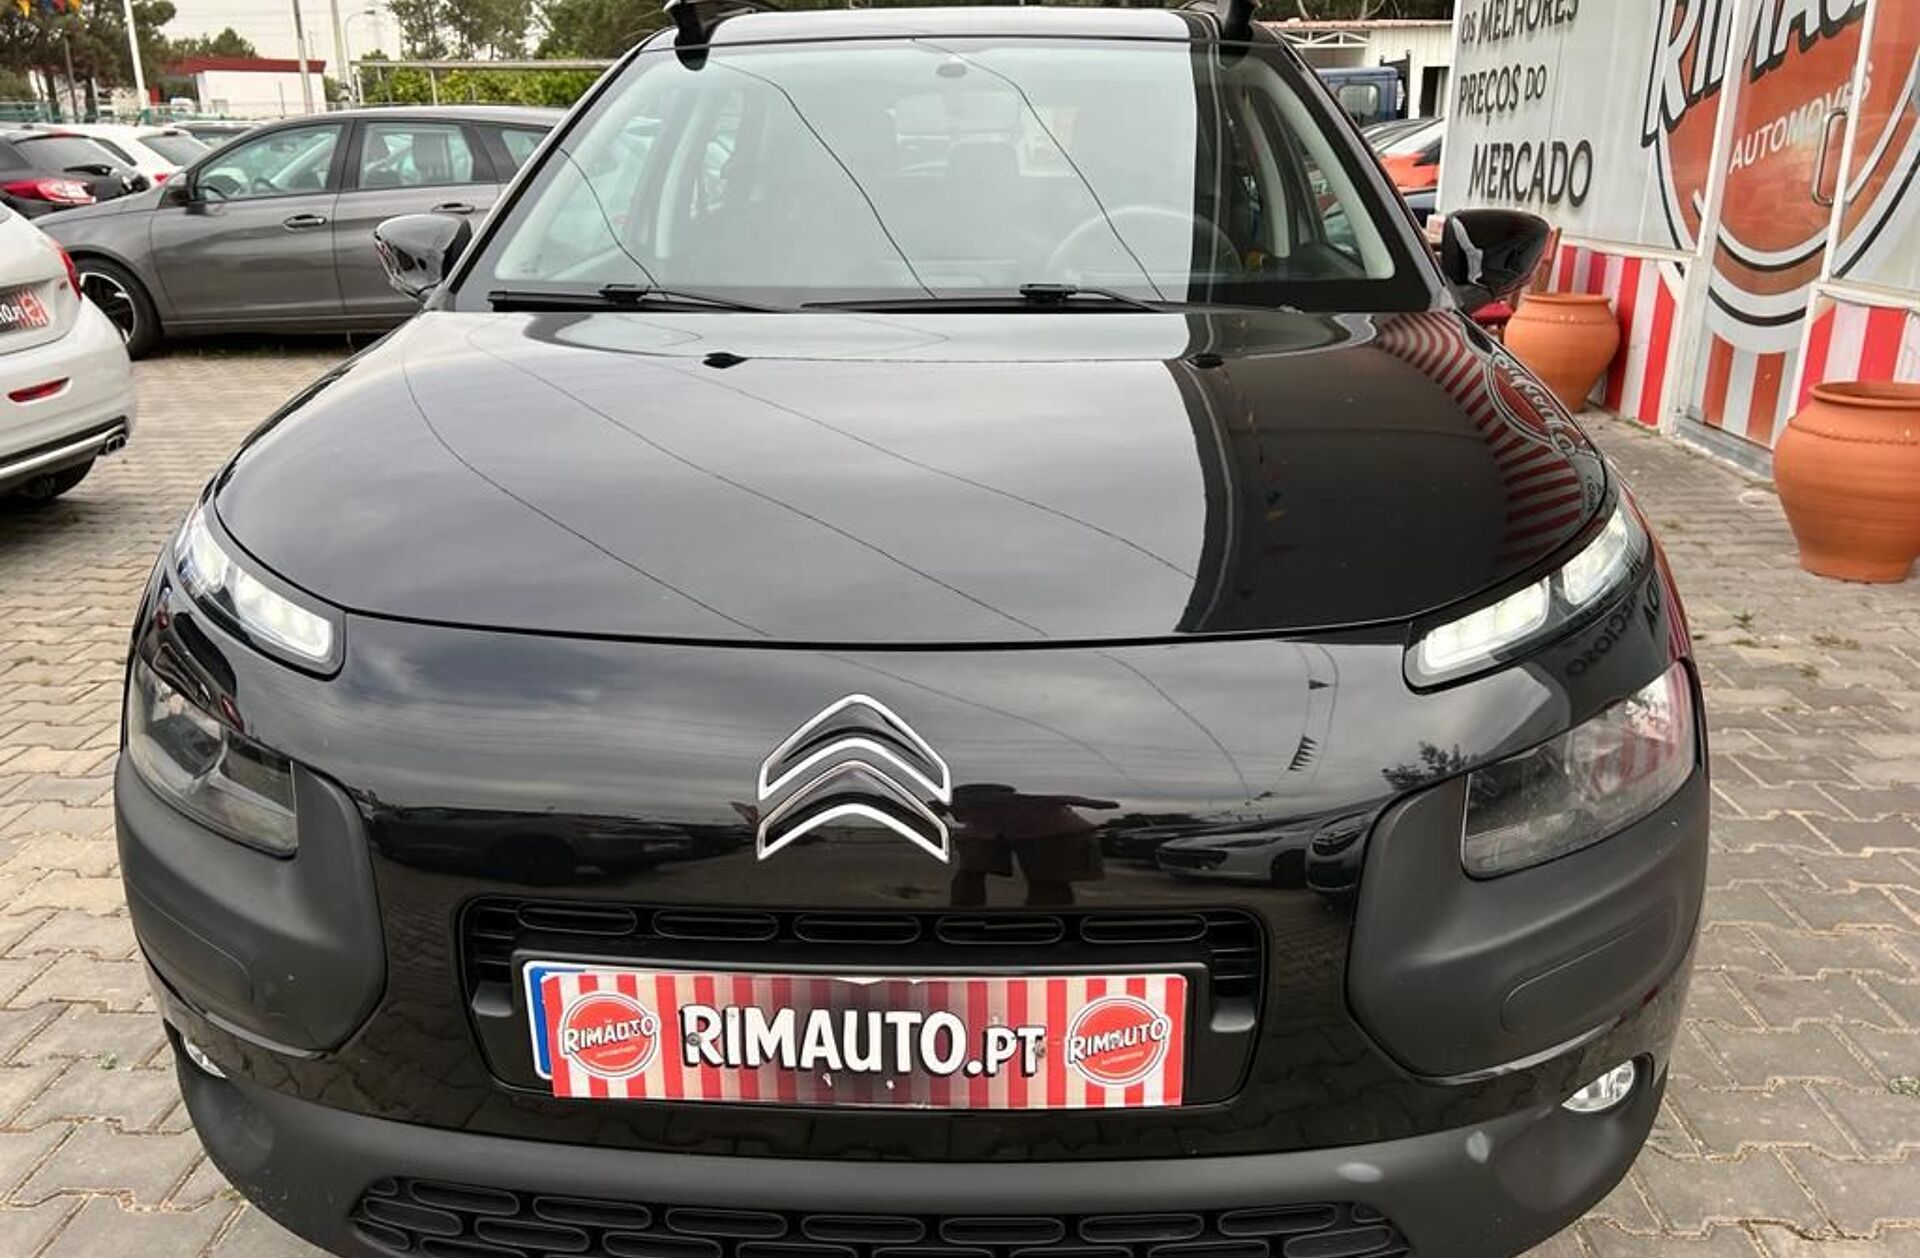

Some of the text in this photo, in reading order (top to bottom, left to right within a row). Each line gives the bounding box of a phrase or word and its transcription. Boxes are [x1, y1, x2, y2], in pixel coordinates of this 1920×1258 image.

[1461, 10, 1477, 44] OS
[1458, 63, 1547, 127] PREÇOS DO
[1468, 139, 1593, 208] MERCADO
[681, 1004, 1046, 1076] RIMAUTO.PT
